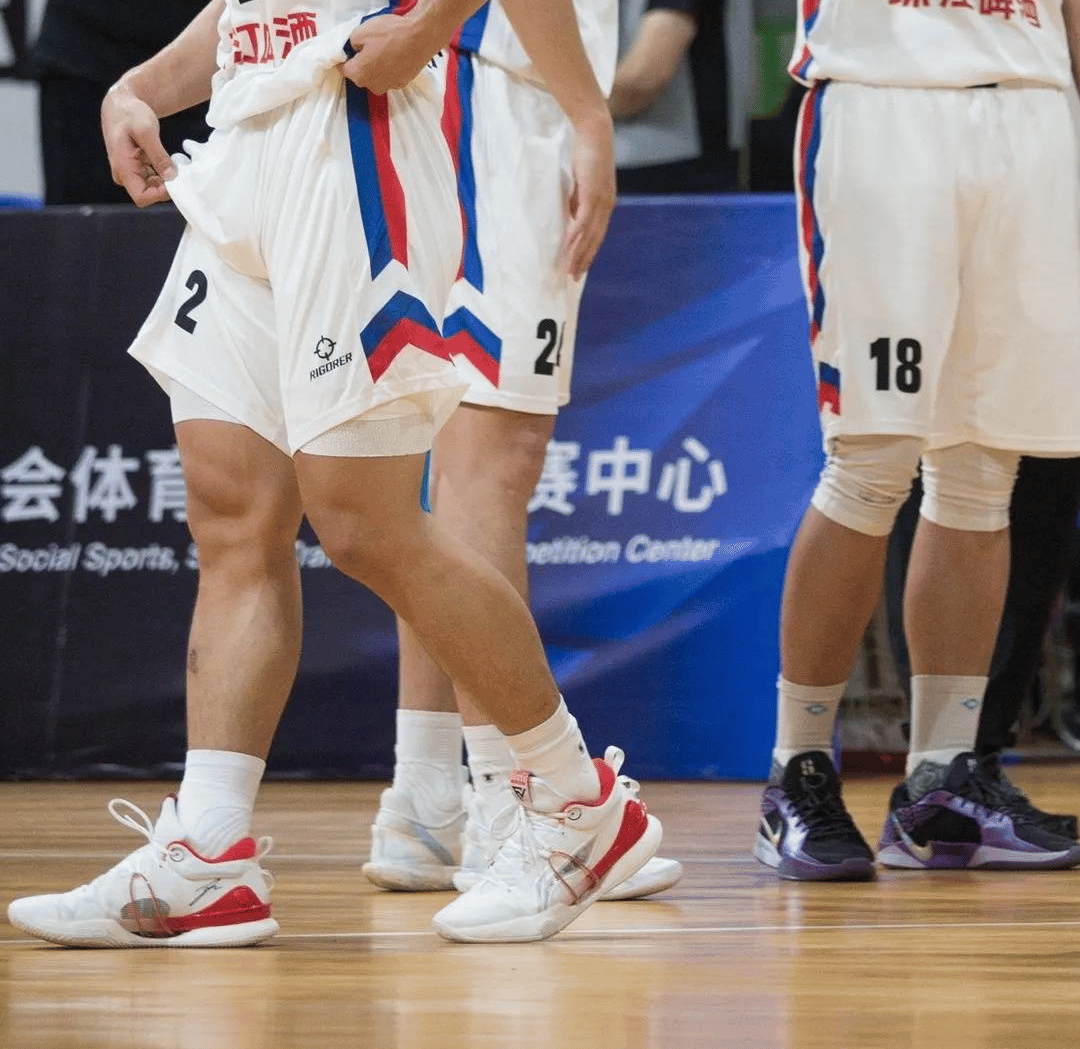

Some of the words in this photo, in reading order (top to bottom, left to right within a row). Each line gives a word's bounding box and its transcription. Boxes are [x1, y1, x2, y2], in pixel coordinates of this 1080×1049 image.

[174, 269, 208, 335] 2
[309, 352, 353, 382] RIGORER
[534, 318, 567, 376] 2
[869, 337, 923, 394] 18
[0, 543, 82, 574] Social
[83, 543, 180, 577] Sports,
[625, 535, 722, 564] Center
